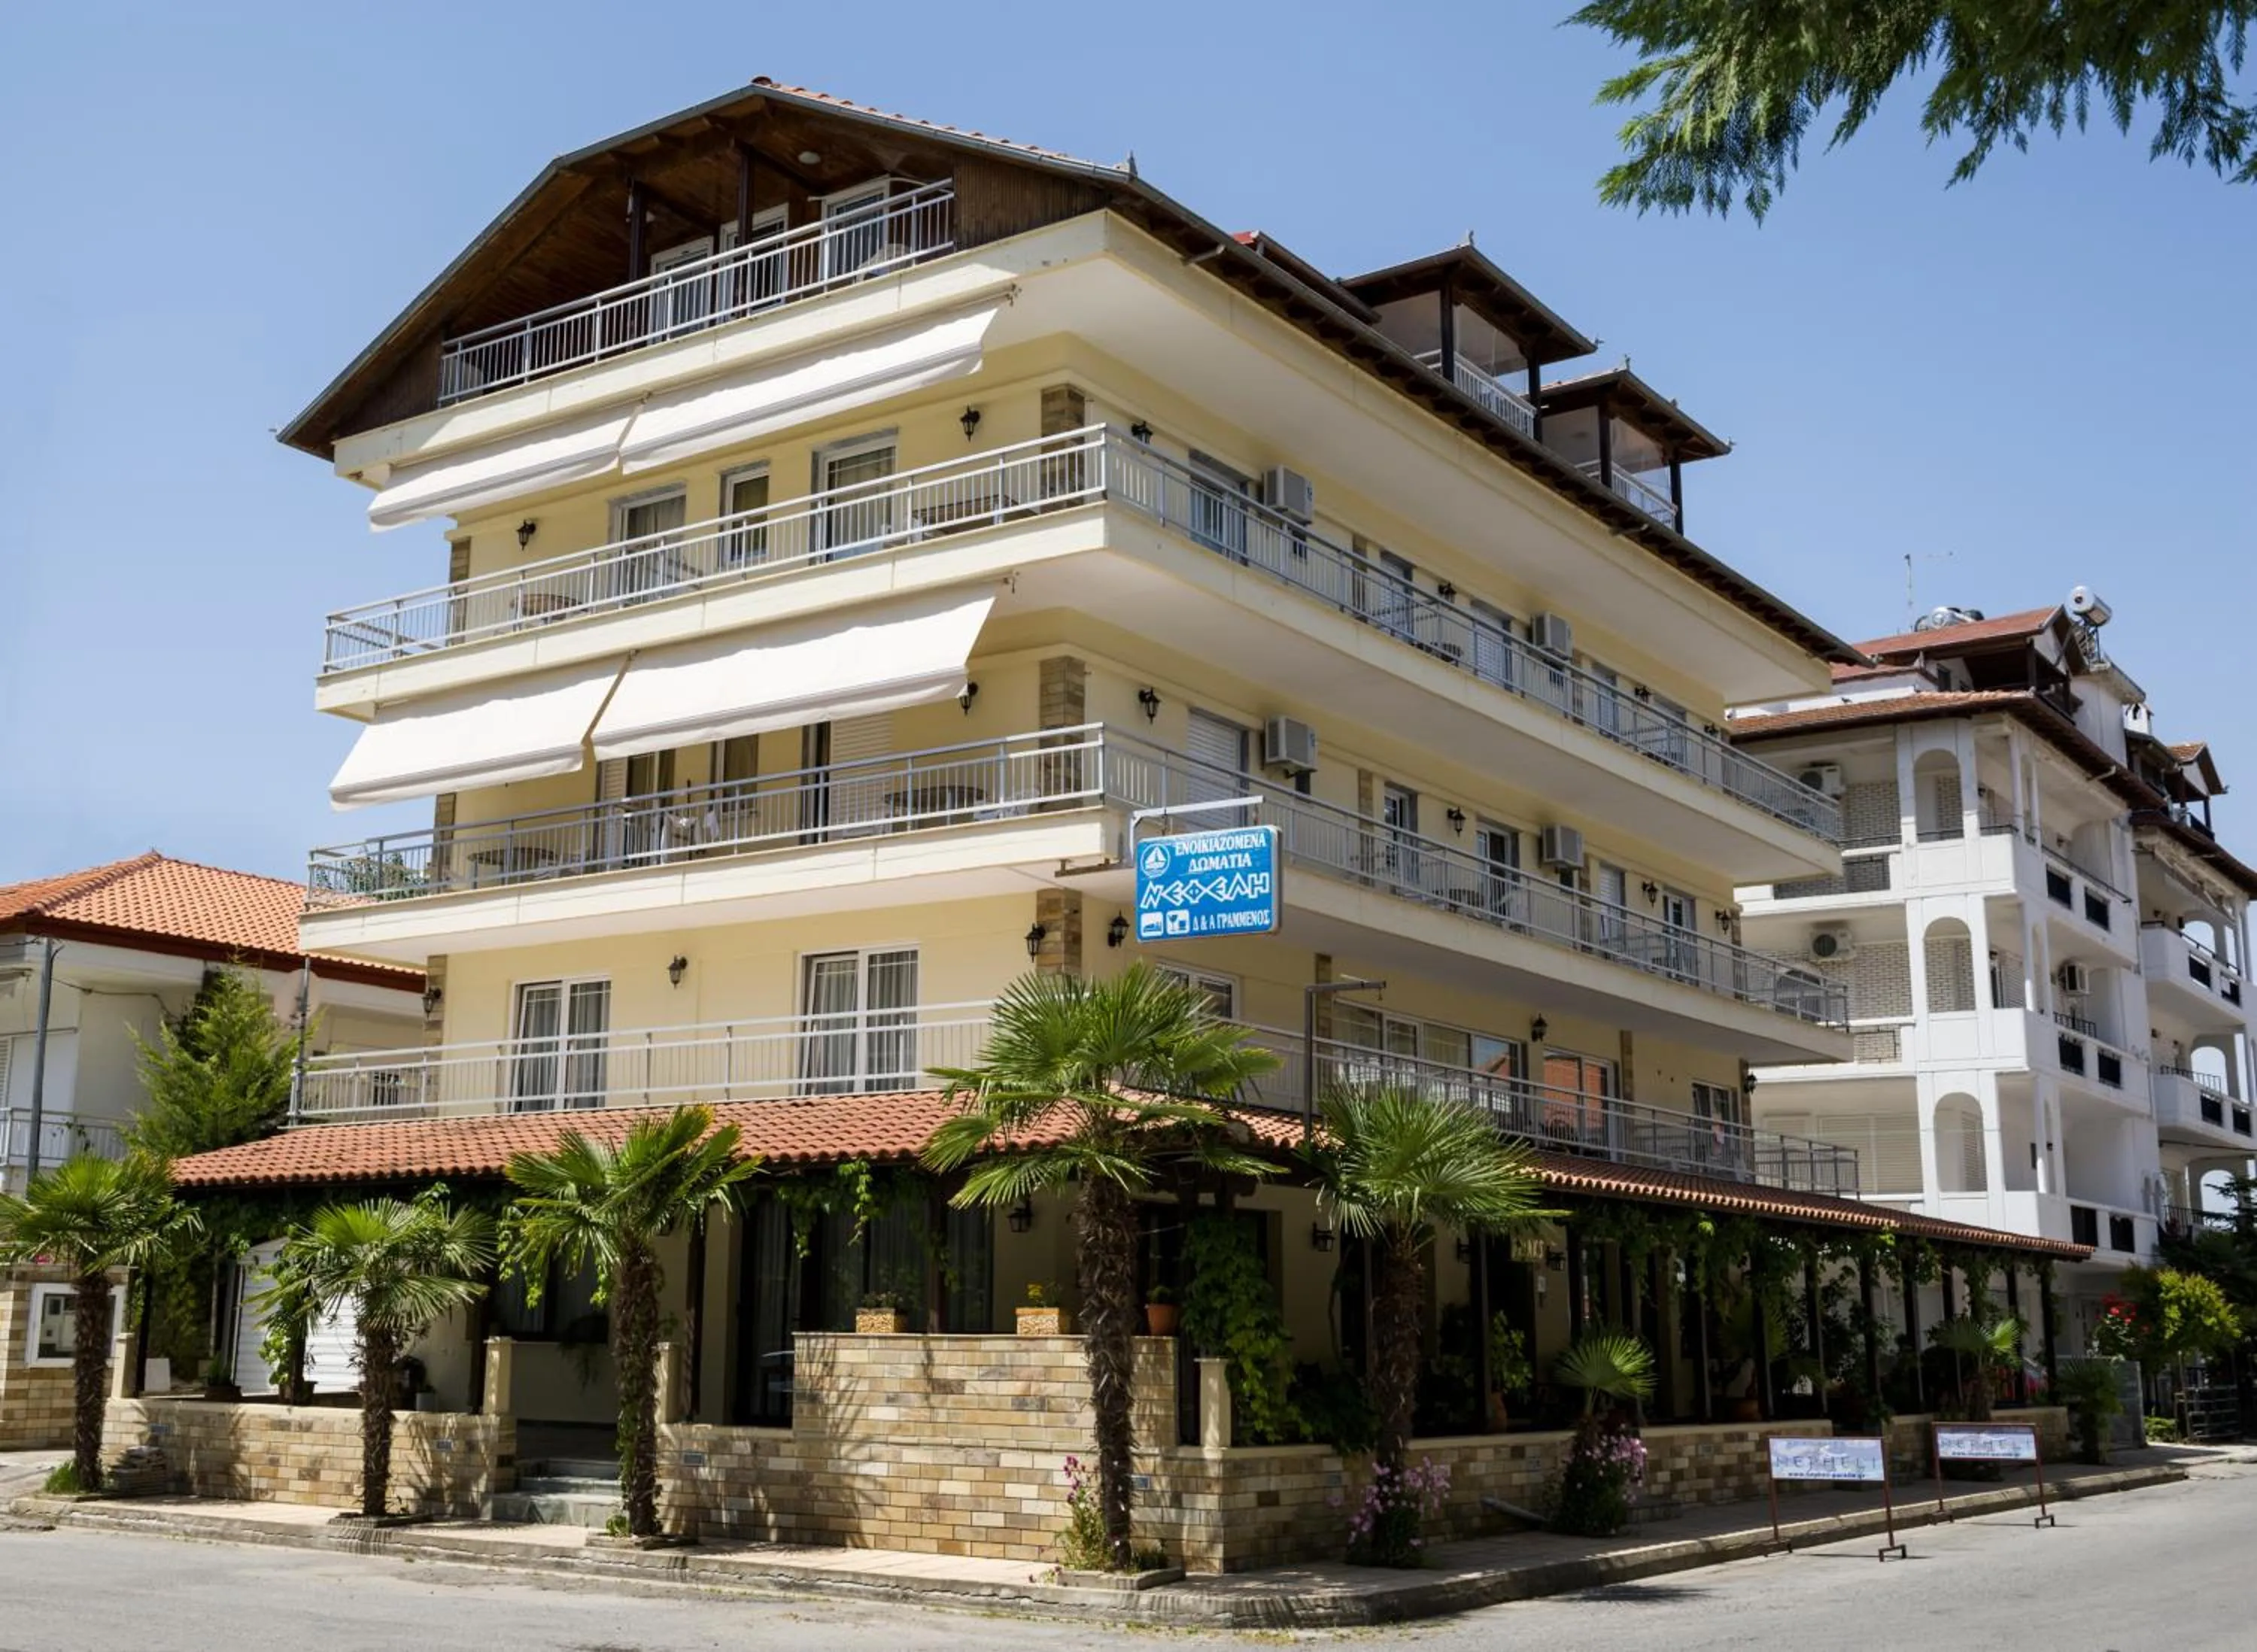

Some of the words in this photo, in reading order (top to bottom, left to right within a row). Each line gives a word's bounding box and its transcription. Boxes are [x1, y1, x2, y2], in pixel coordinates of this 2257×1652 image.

[1175, 833, 1266, 856] ΕΝΟΙΚΙΑΖΟΜΕΝΑ
[1188, 852, 1252, 873] ΔΩΜΑΤΙΑ
[1140, 873, 1270, 909] ΝΕΦΕΛΗ
[1192, 916, 1199, 931] Δ
[1200, 915, 1208, 931] &
[1208, 914, 1216, 930] Α
[1217, 910, 1271, 928] ΓΡΑΜΜΕΝΟΣ
[1776, 1455, 1876, 1469] NEPHELI
